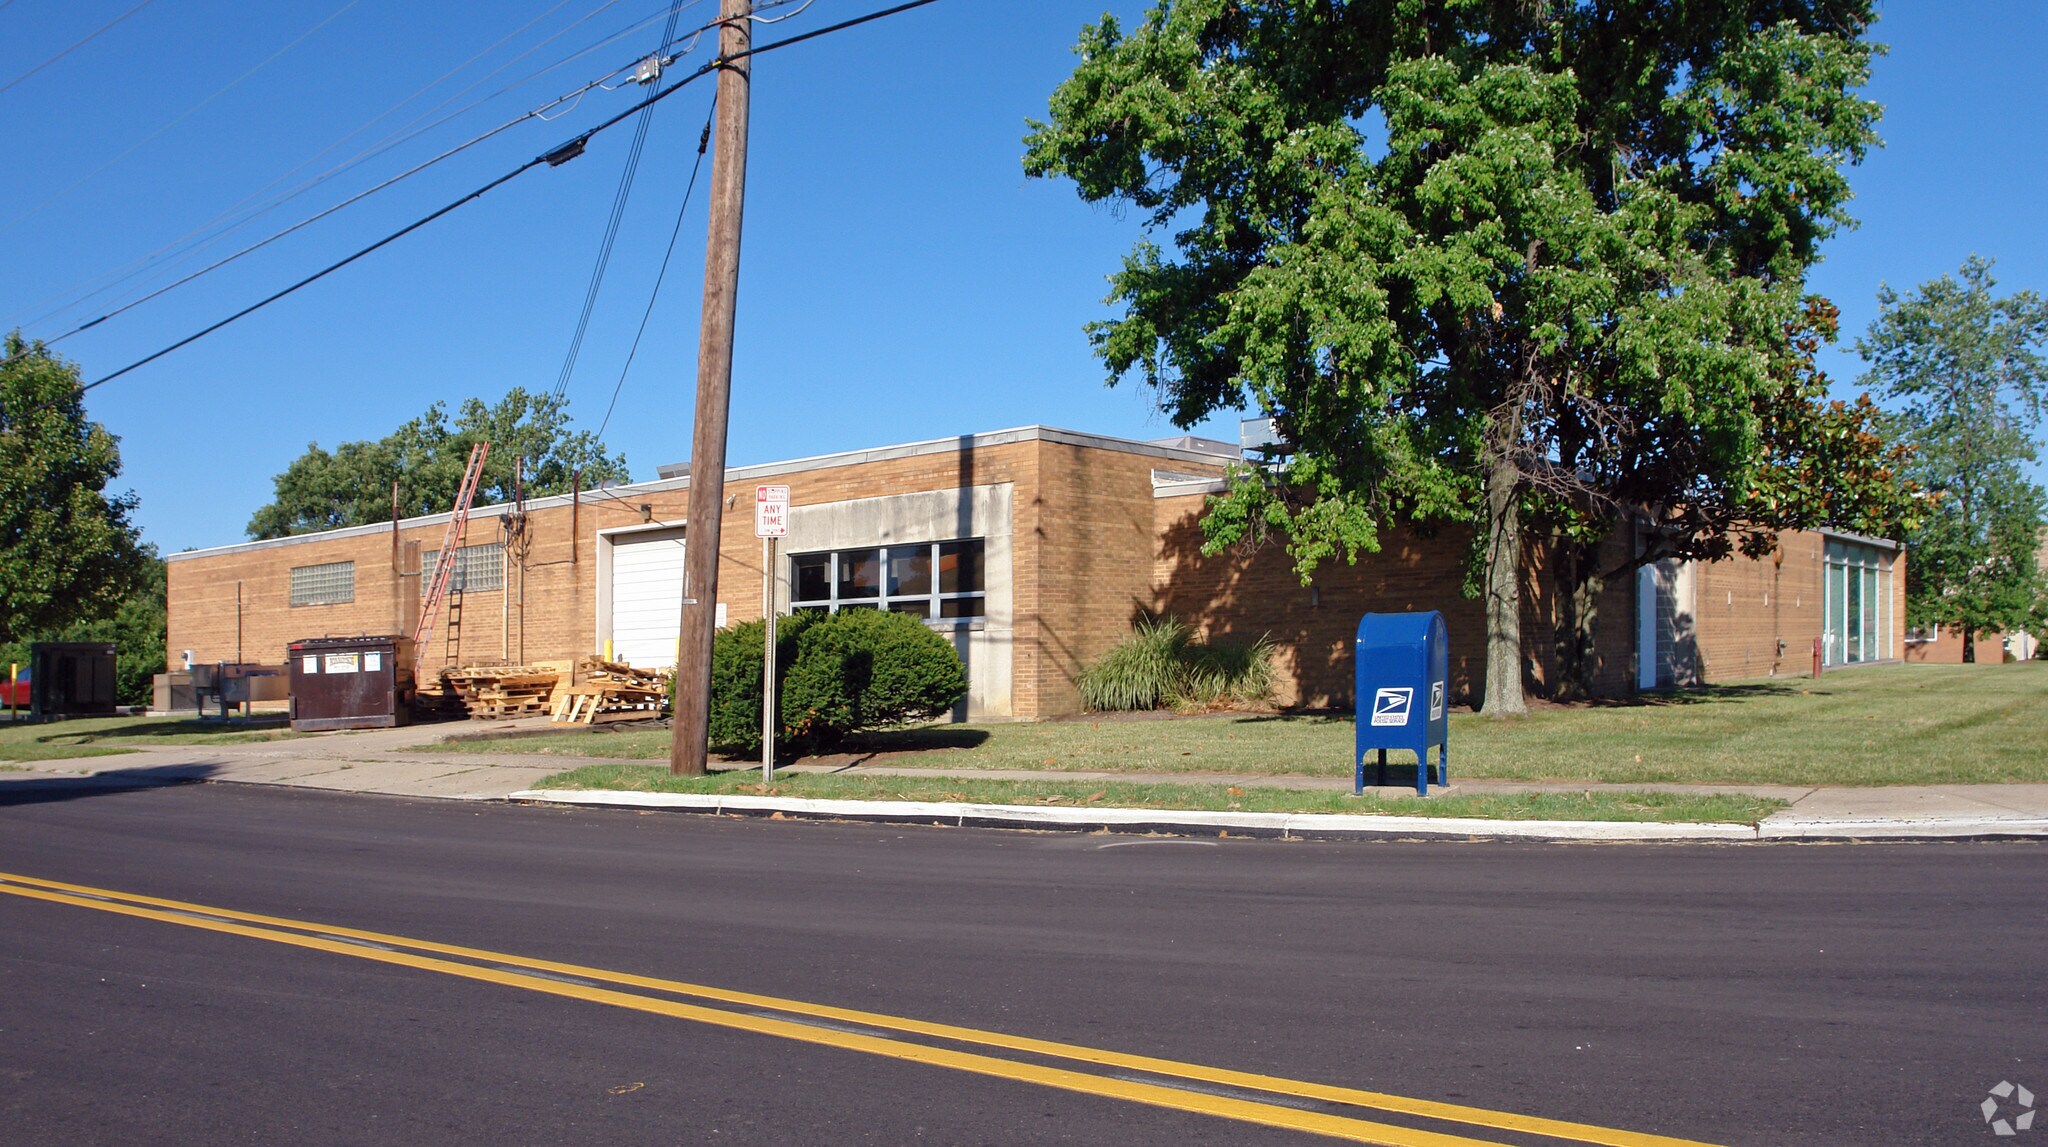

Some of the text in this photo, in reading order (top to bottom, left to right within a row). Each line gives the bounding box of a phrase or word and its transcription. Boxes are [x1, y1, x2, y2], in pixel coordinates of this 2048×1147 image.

[758, 490, 766, 500] NO
[764, 505, 781, 514] ANY
[763, 516, 782, 525] TIME
